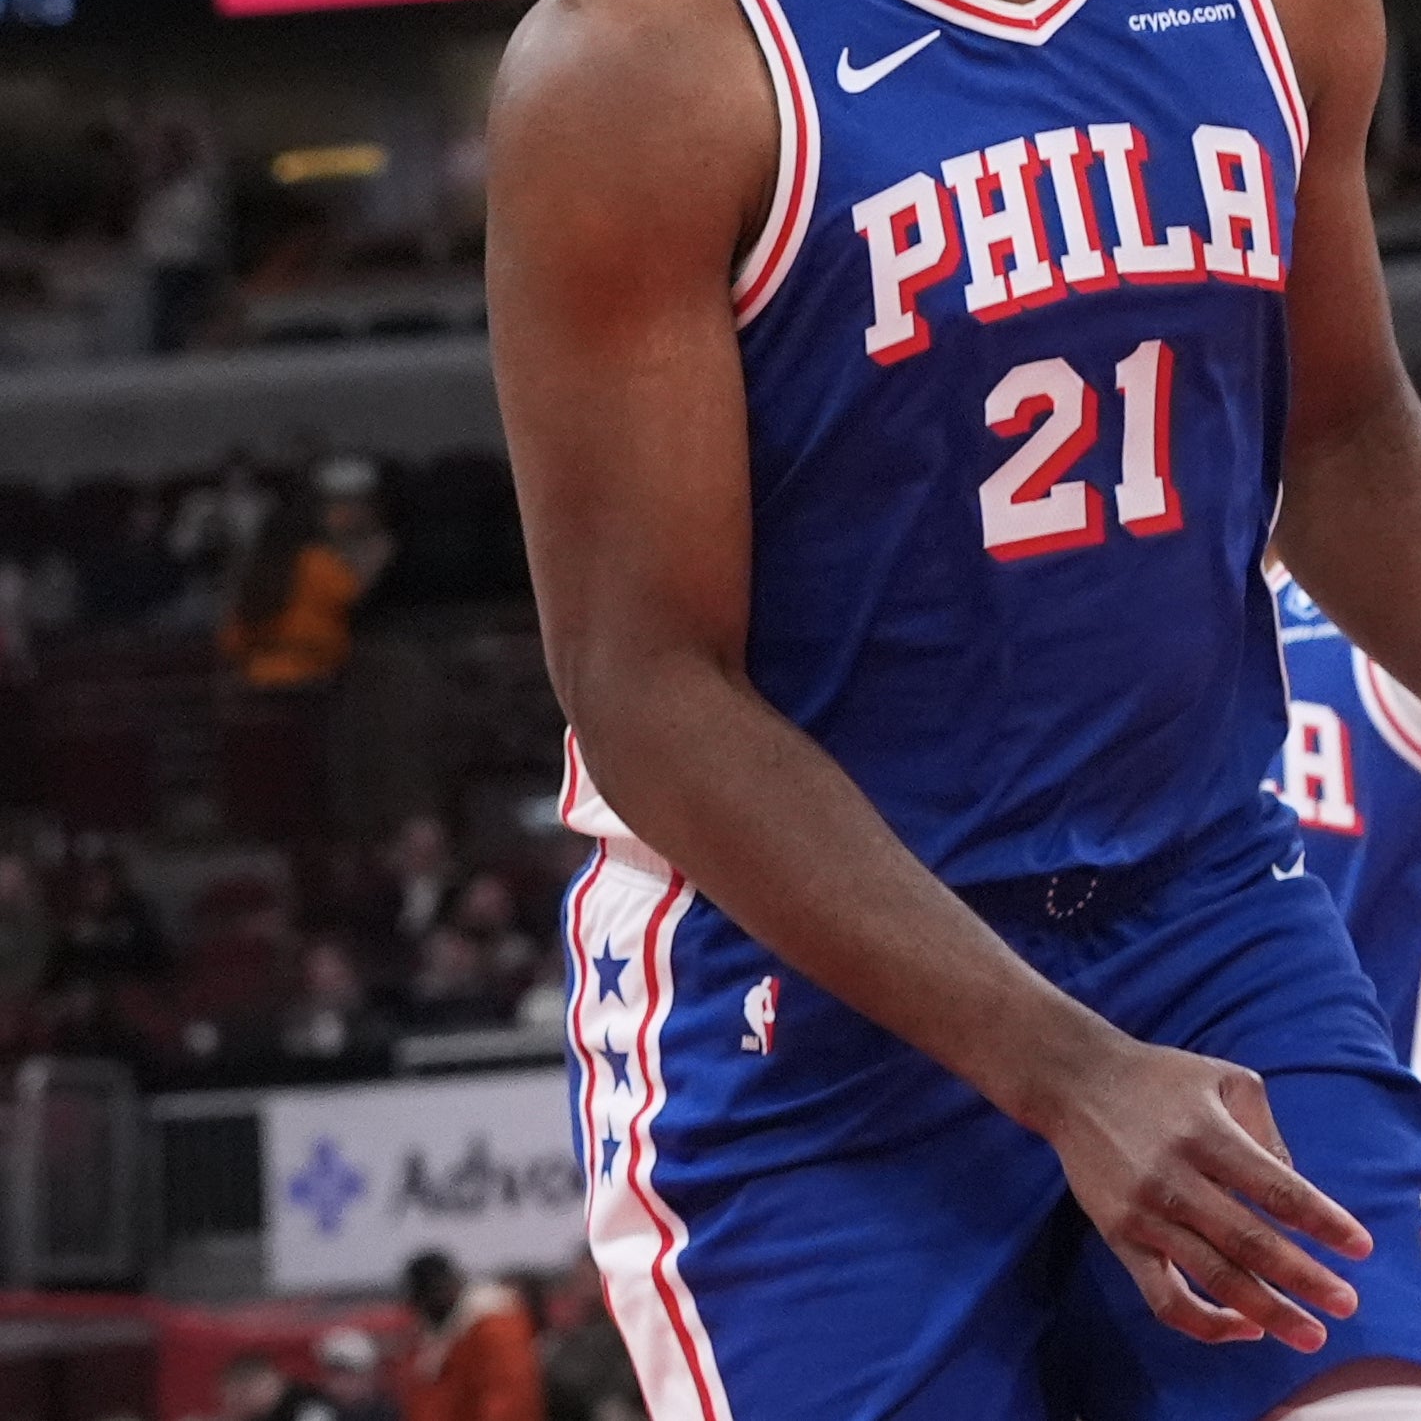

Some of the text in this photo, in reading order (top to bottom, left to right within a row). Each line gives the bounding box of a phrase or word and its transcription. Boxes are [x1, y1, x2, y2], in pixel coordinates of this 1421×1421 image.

[1128, 3, 1236, 32] crypto.com
[852, 122, 1287, 367] PHILA
[979, 339, 1183, 561] 21
[393, 1129, 586, 1216] Advo
